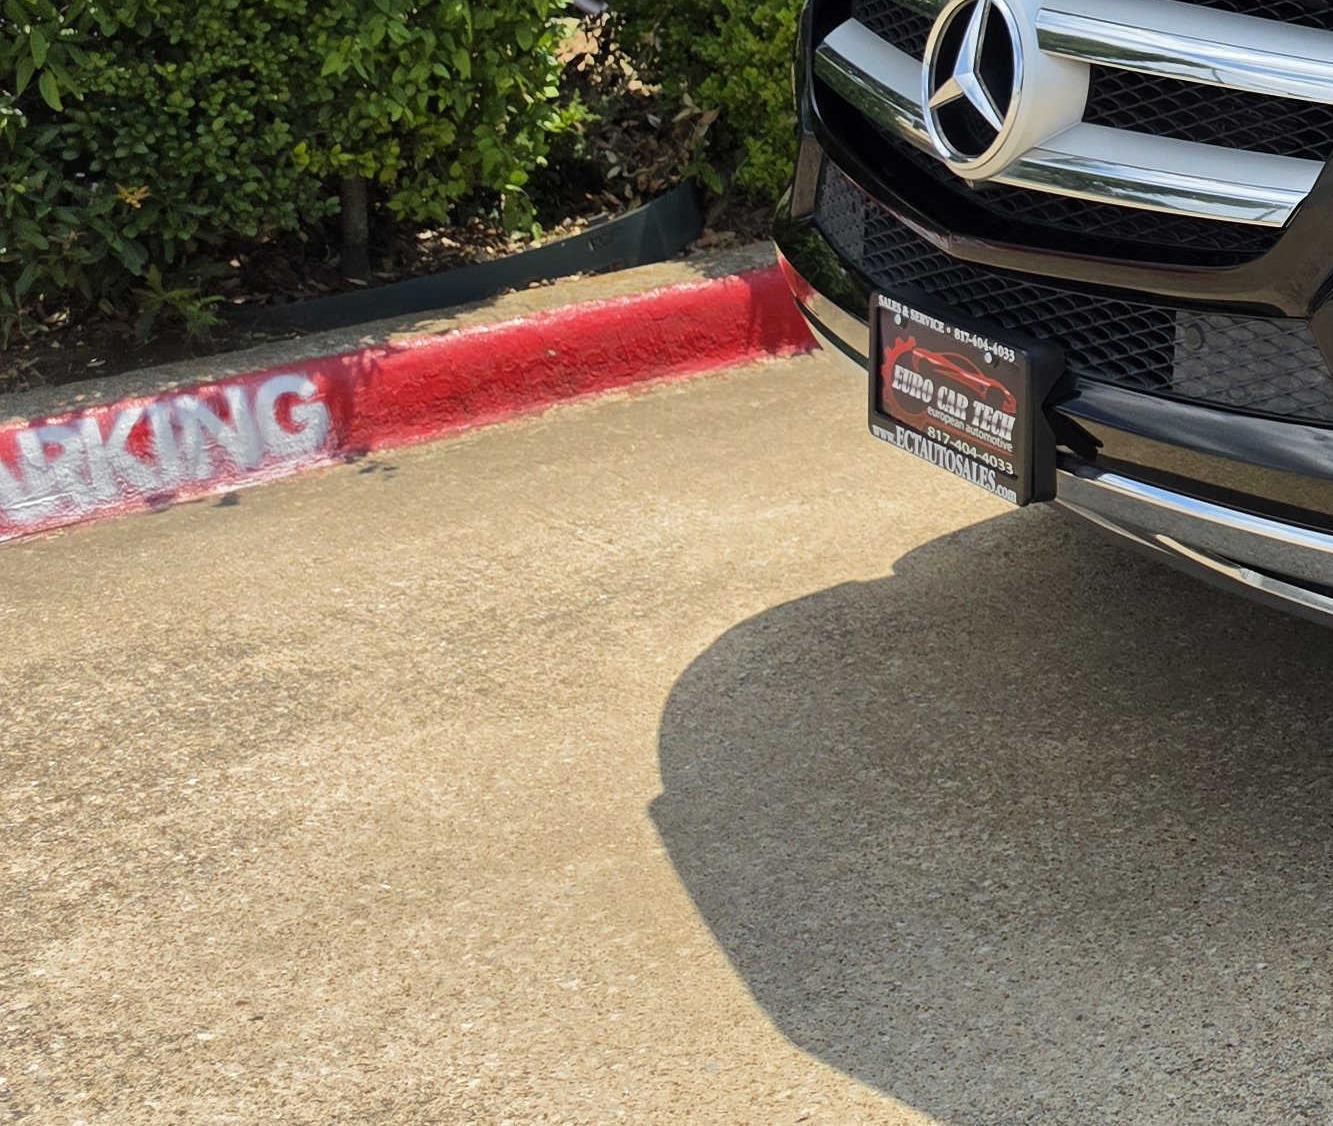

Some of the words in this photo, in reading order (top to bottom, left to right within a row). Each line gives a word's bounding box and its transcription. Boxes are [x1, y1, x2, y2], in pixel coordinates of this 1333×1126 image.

[879, 294, 902, 314] SALES
[902, 305, 909, 319] &
[910, 309, 945, 334] SERVICE
[954, 328, 1015, 363] 817-404-4033
[892, 364, 934, 403] EURO
[937, 386, 969, 421] CAR
[972, 401, 1016, 441] TECH
[927, 406, 965, 431] european
[965, 424, 1013, 453] automotive
[871, 425, 1017, 504] www.ECTAUTOSALES.com
[927, 426, 1014, 475] 817-404-4033
